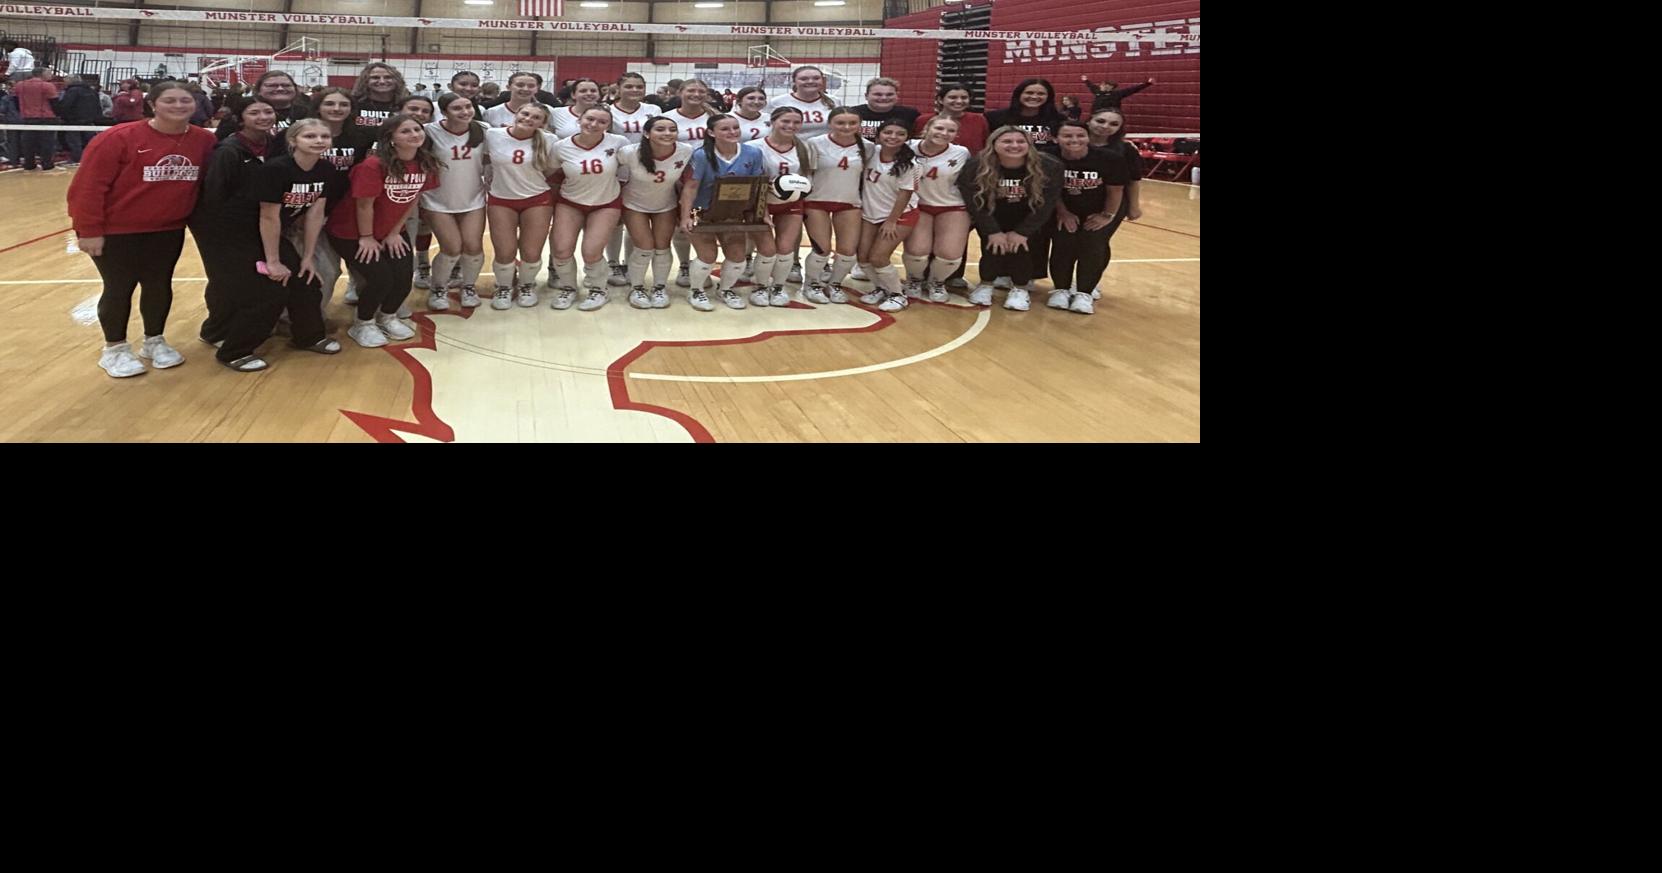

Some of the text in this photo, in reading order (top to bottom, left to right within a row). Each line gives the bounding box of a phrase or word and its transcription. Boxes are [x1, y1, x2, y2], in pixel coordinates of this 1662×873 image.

[205, 12, 375, 25] MUNSTER VOLLEYBALL
[478, 20, 635, 31] MUNSTER VOLLEYBALL
[730, 26, 876, 36] MUNSTER VOLLEYBALL
[964, 30, 1098, 40] MUNSTER VOLLEYBALL
[360, 109, 390, 119] BUILT
[802, 111, 824, 124] 13
[623, 120, 642, 134] 11
[750, 127, 761, 139] 2
[686, 127, 705, 141] 10
[450, 145, 472, 161] 12
[511, 149, 525, 165] 8
[579, 159, 604, 175] 16
[837, 156, 850, 171] 4
[653, 170, 666, 184] 3
[1082, 171, 1099, 180] TO
[999, 179, 1021, 187] UILT
